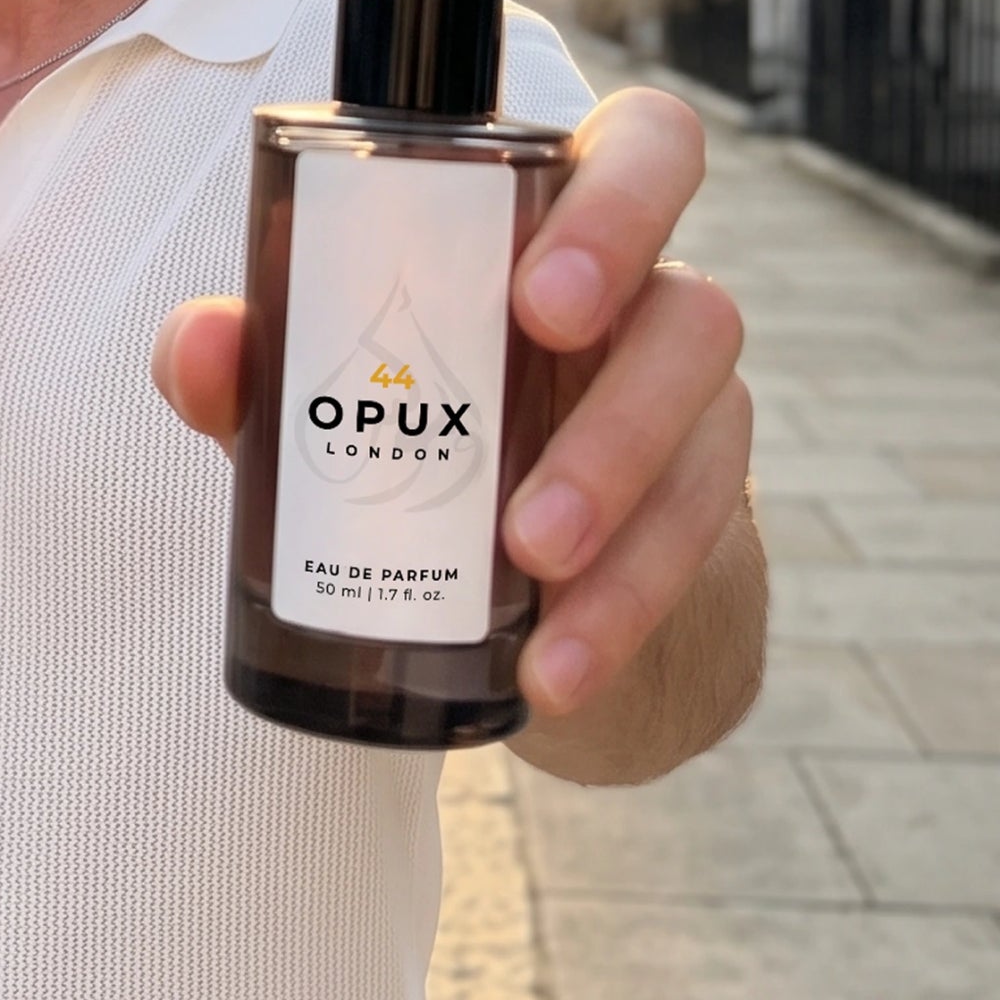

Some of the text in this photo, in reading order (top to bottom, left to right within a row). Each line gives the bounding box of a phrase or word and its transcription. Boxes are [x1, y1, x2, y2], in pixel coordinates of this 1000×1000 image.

[369, 363, 415, 389] 44
[308, 396, 471, 437] OPUX
[326, 442, 450, 461] LONDON
[304, 560, 458, 582] EAU DE PARFUM
[315, 581, 336, 596] 50
[341, 586, 362, 599] ml
[378, 588, 398, 601] 1.7
[403, 588, 417, 601] fl.
[422, 591, 446, 601] oz.
